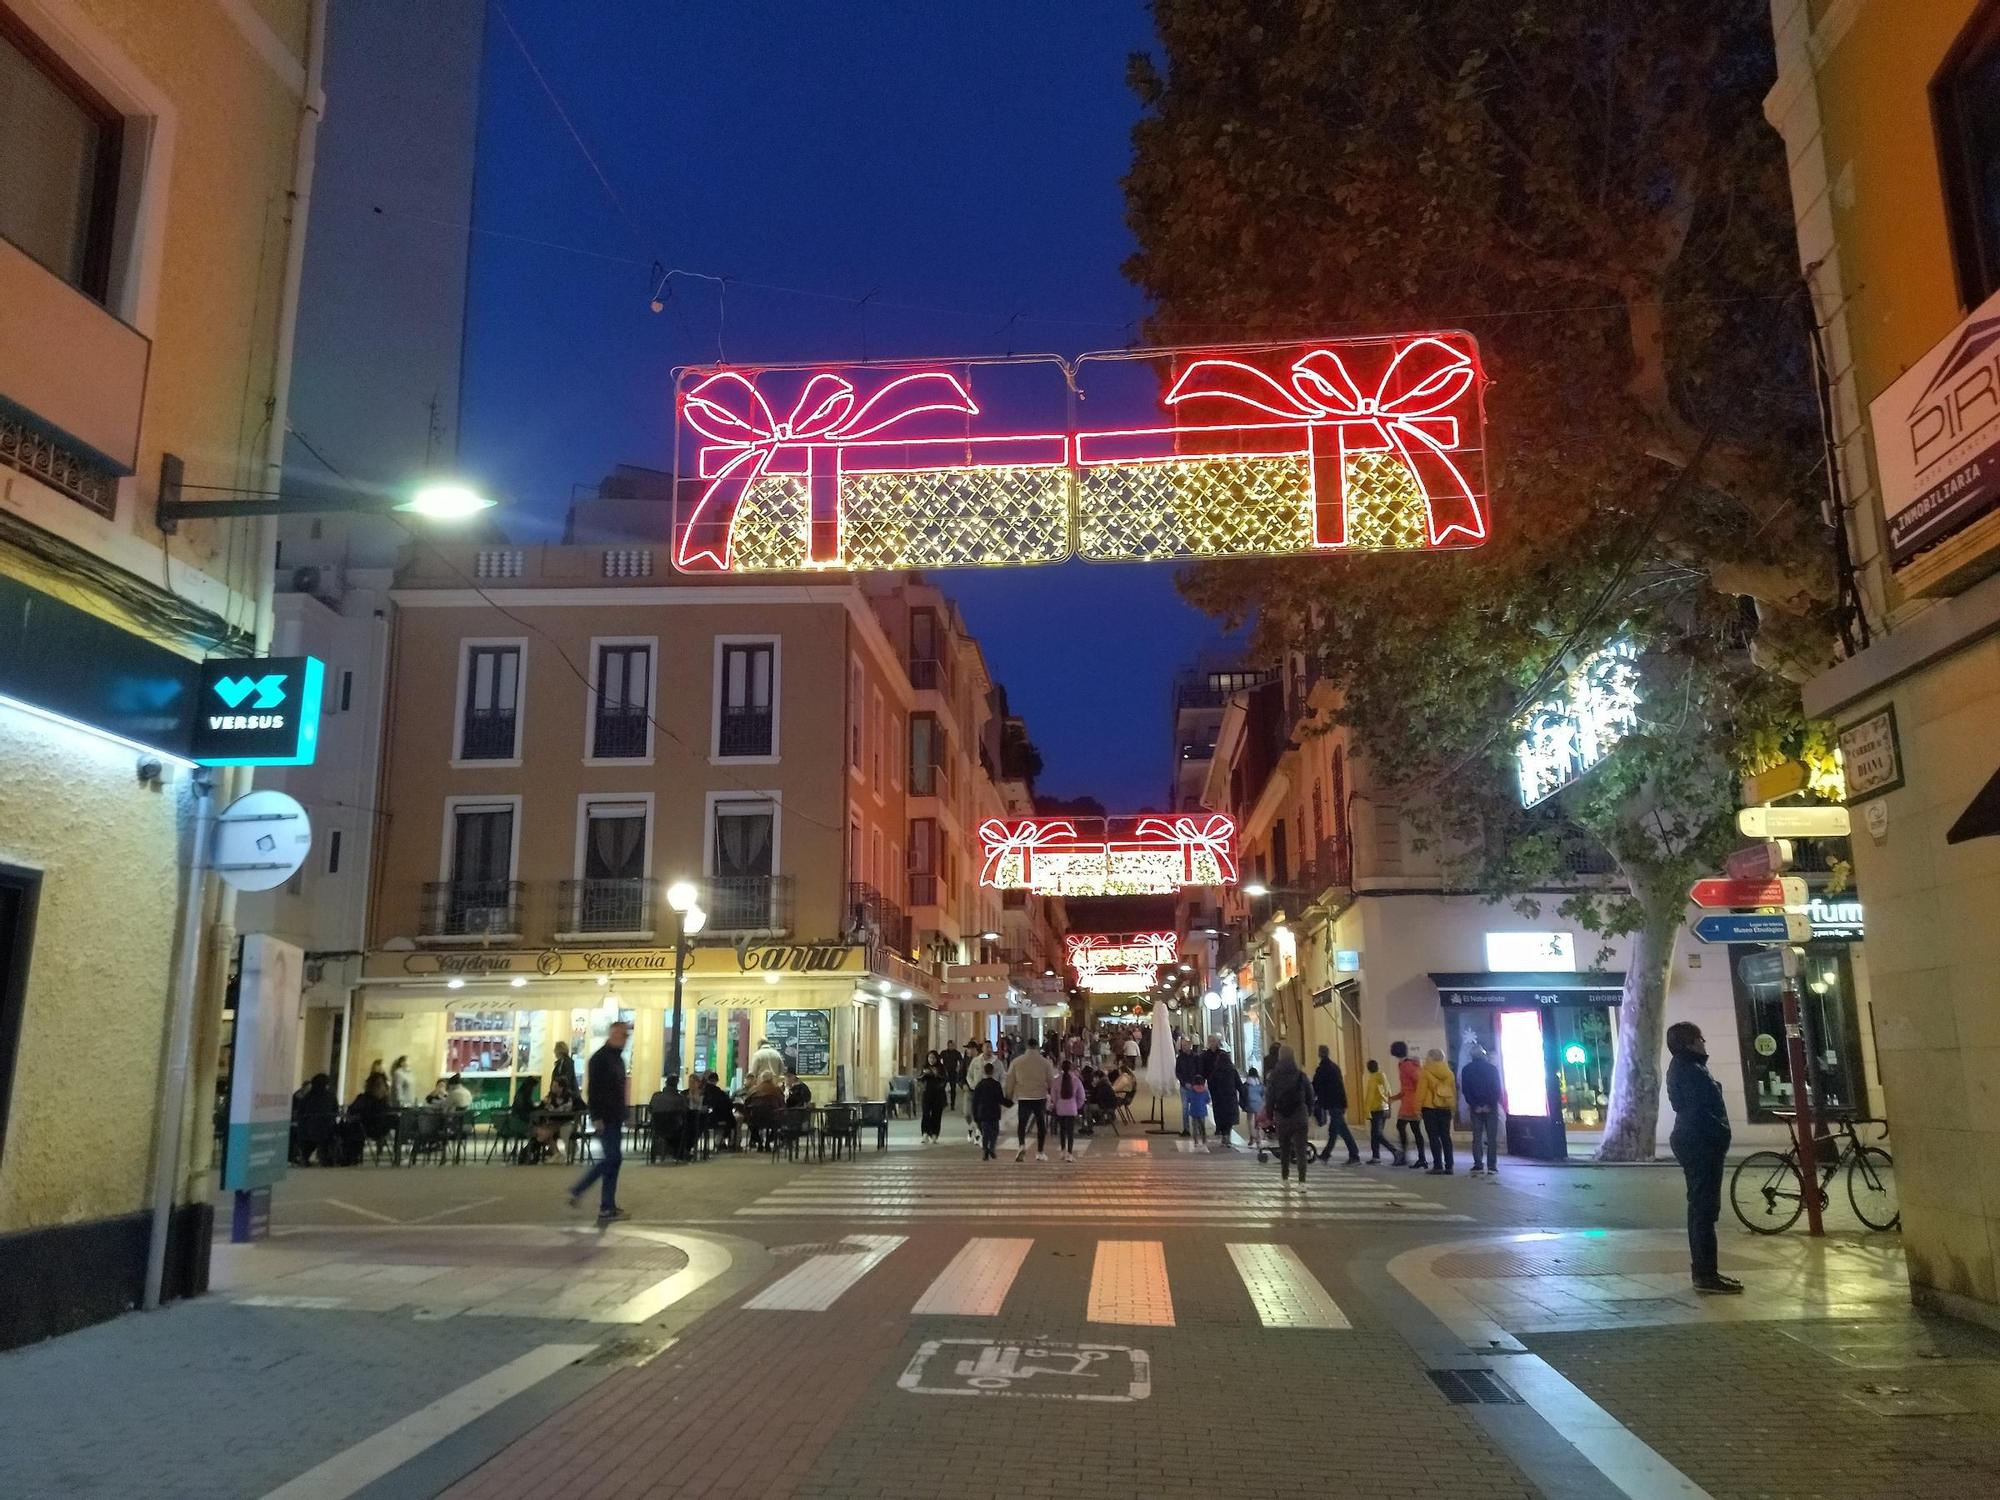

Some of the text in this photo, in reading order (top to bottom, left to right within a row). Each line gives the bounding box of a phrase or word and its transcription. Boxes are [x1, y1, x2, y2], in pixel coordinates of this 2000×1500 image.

[1898, 463, 1981, 531] INMOBILIARIA
[209, 715, 285, 730] VERSUS
[1857, 756, 1884, 777] DIANA
[1540, 994, 1560, 1004] art
